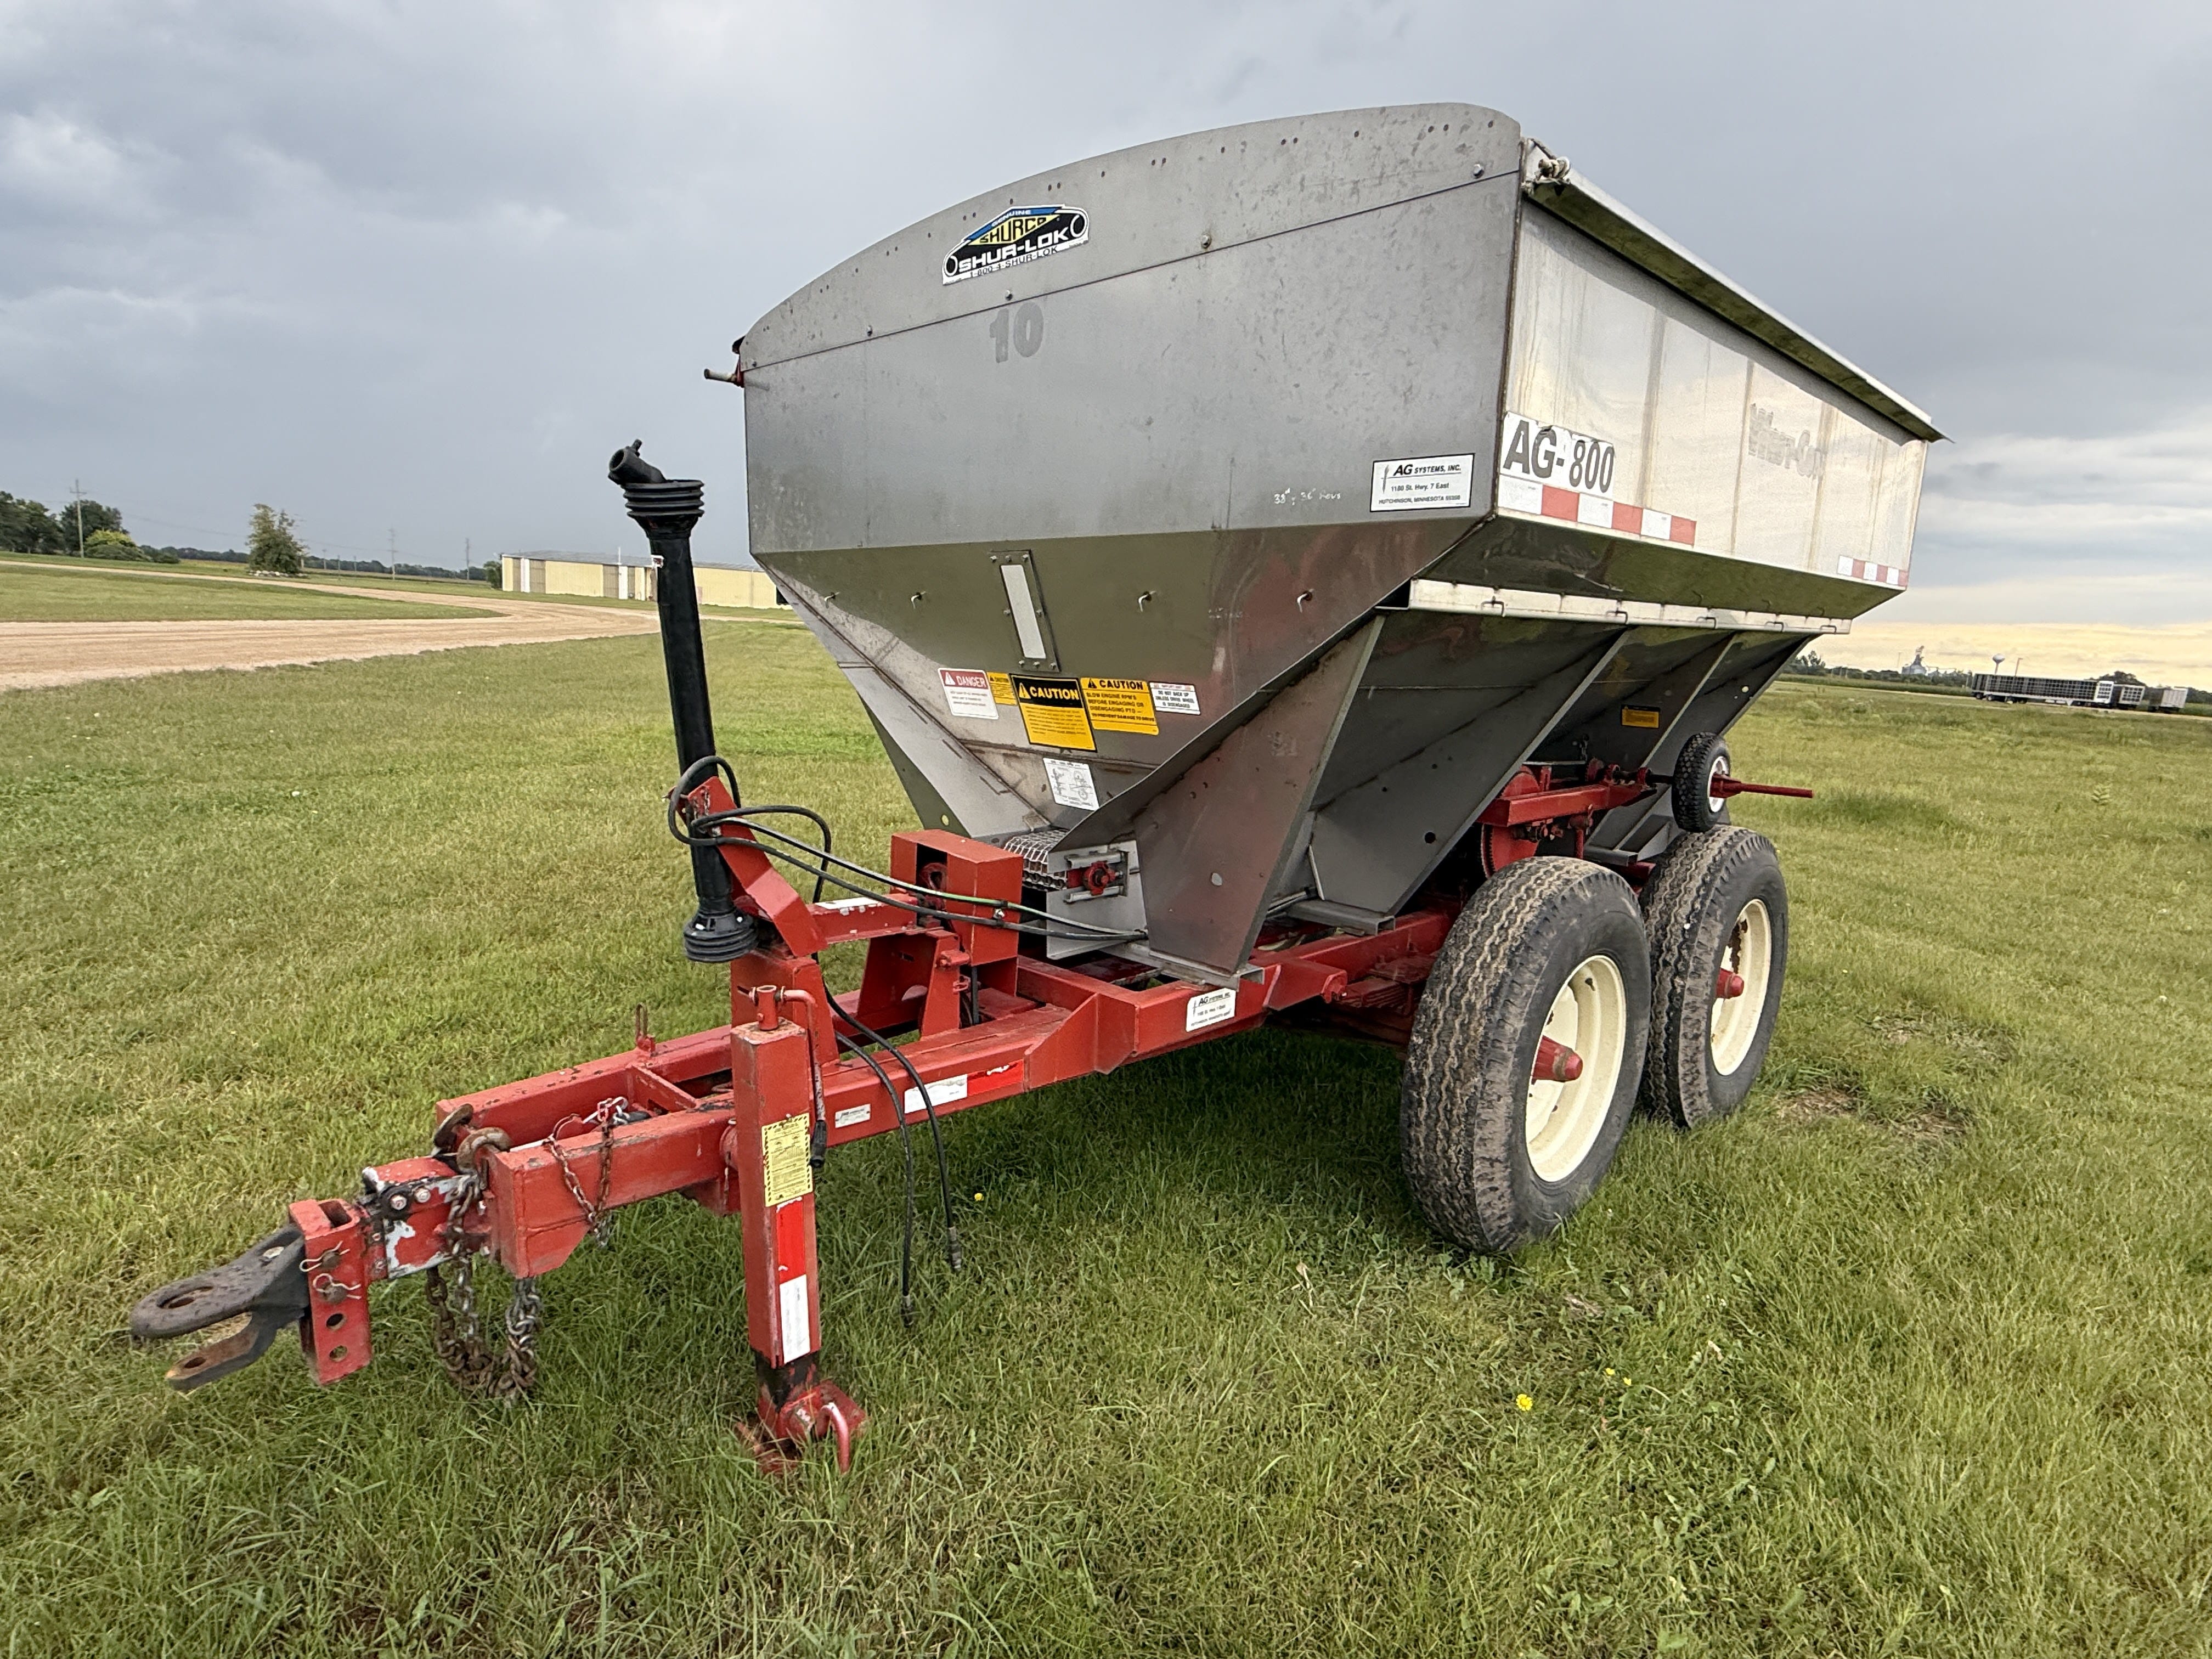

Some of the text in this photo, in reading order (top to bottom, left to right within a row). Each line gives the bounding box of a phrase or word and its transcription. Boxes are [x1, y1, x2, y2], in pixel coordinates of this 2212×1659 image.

[991, 210, 1031, 227] GENUINE
[979, 217, 1047, 244] SHURCO
[958, 226, 1069, 273] SHUR-LOK
[989, 302, 1044, 363] 10
[1393, 464, 1413, 476] AG
[1414, 465, 1446, 474] SYSTEMS,
[1415, 483, 1429, 492] Hwy.
[956, 675, 986, 688] DANGER
[1099, 679, 1144, 690] CAUTION
[1029, 686, 1080, 701] CAUTION
[1198, 996, 1209, 1006] AG
